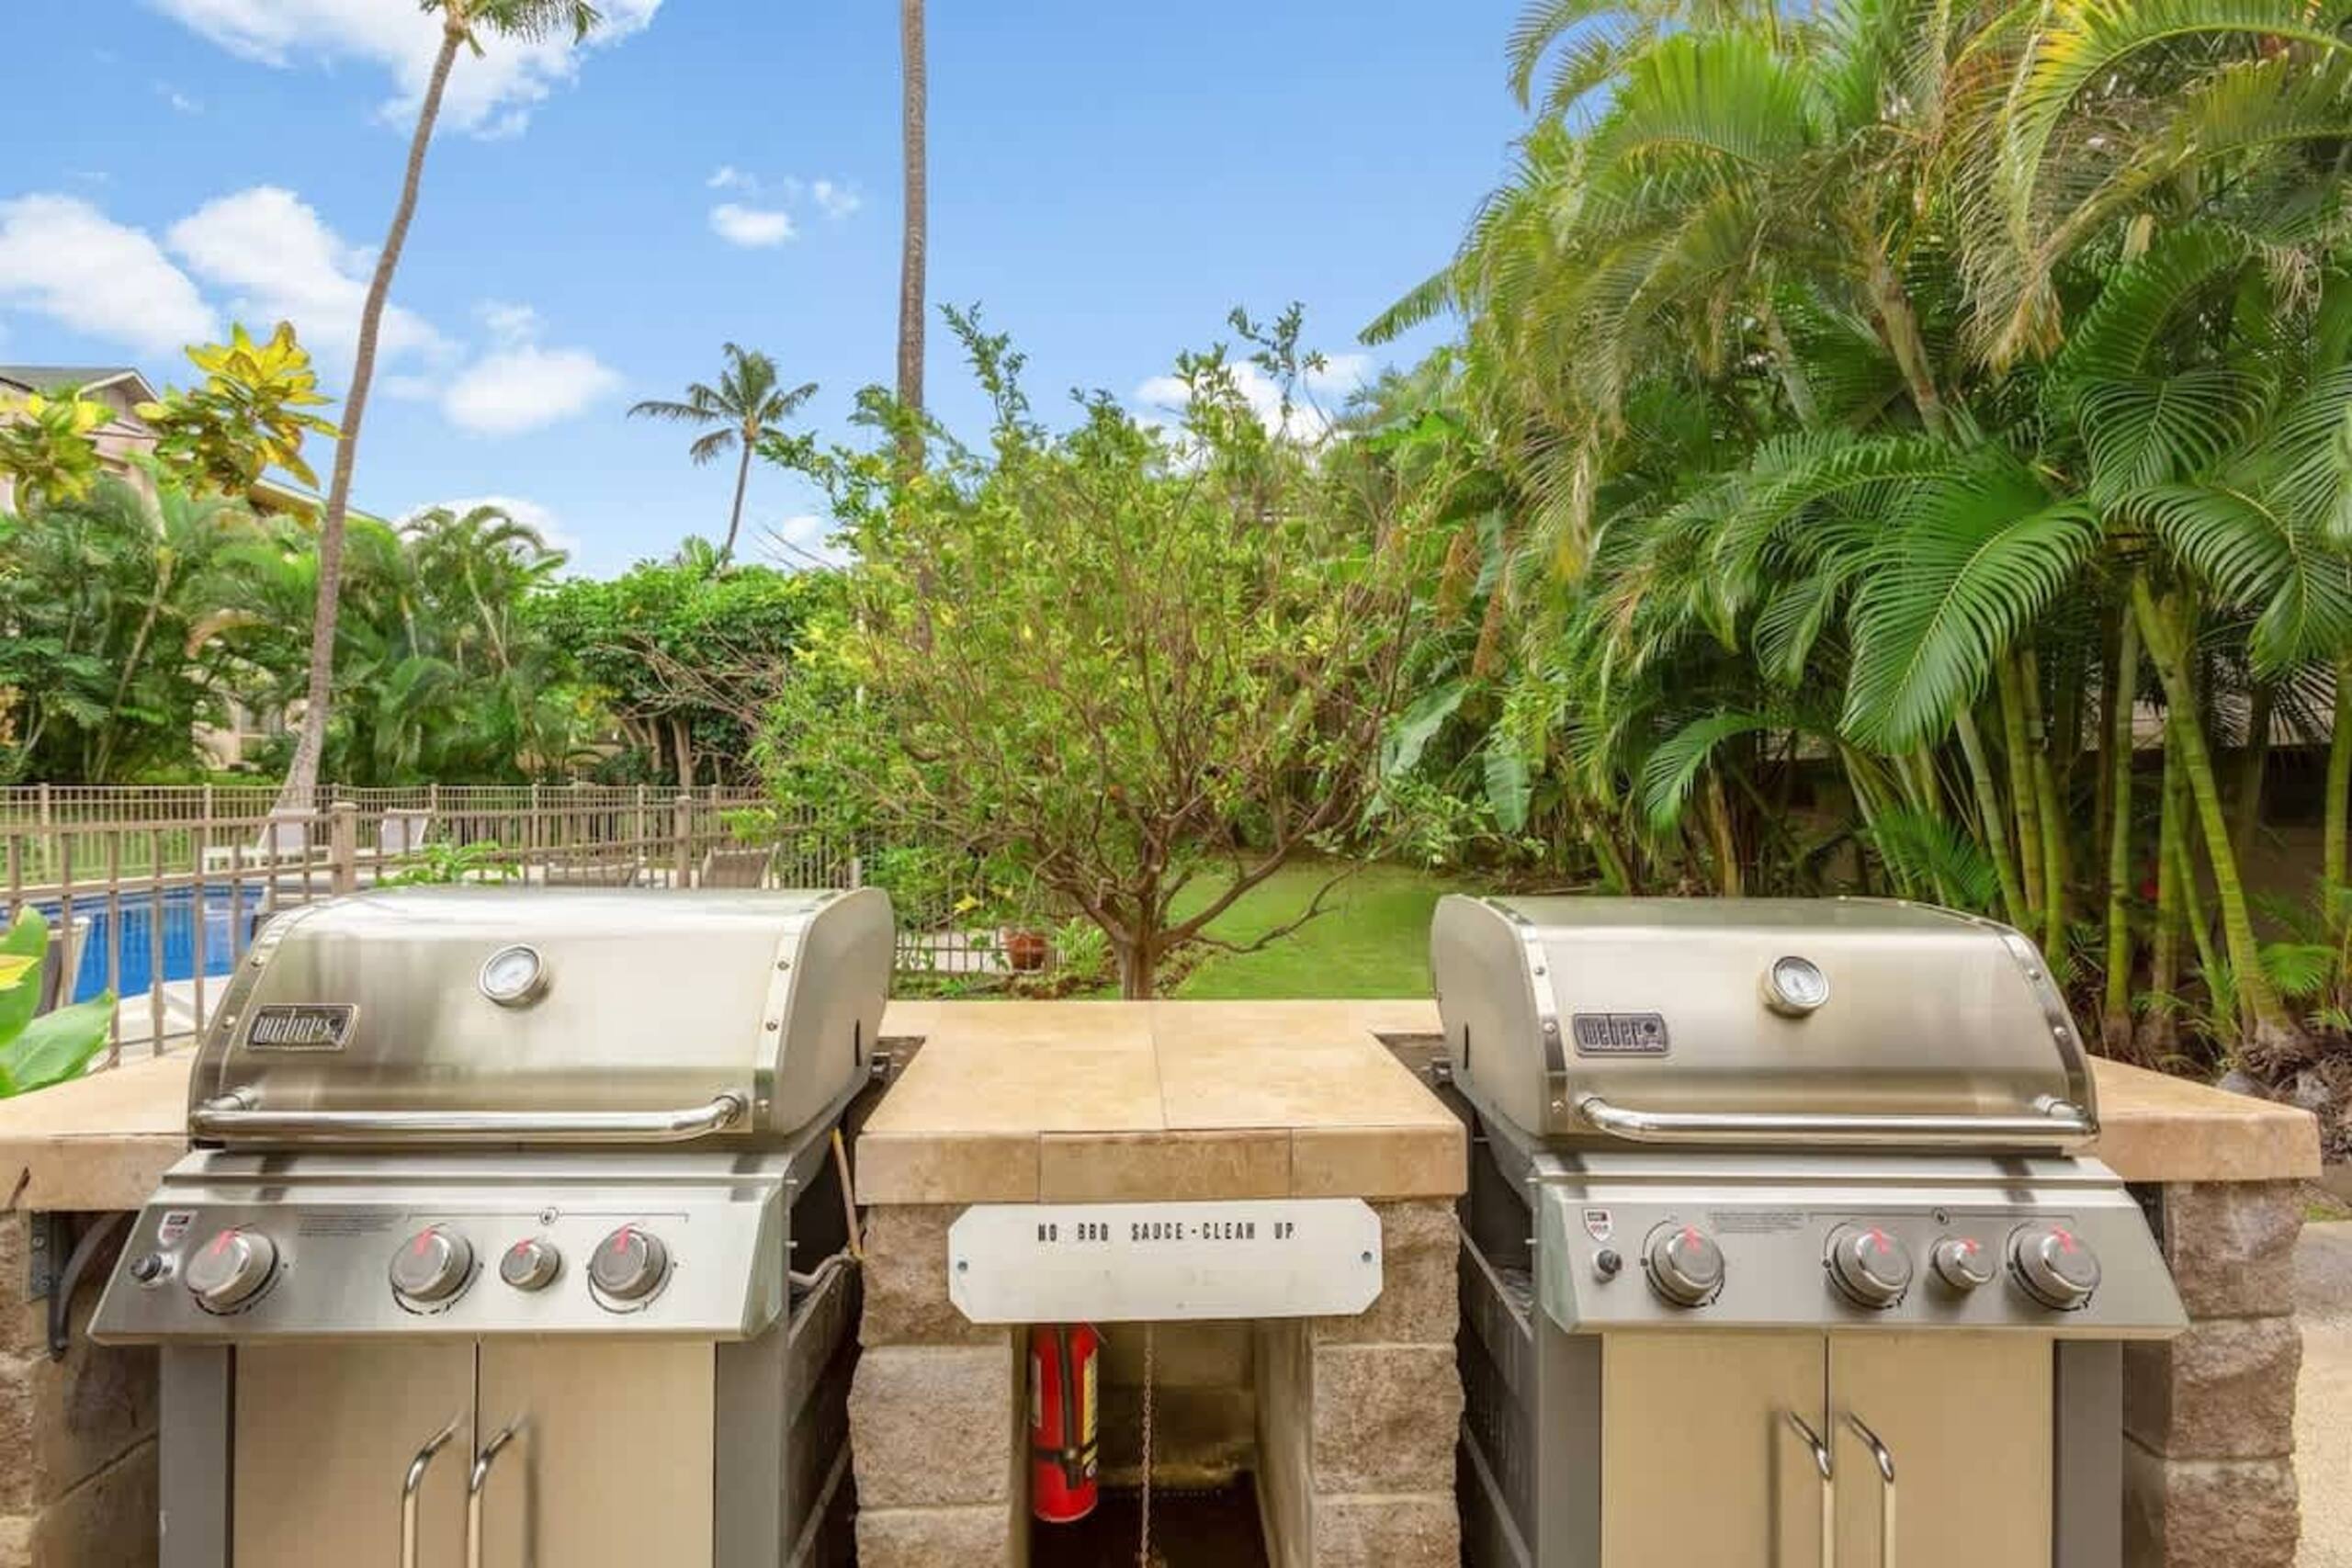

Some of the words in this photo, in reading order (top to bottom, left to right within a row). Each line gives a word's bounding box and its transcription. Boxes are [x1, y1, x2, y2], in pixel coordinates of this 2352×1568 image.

[1580, 1014, 1645, 1048] weber
[1037, 1223, 1057, 1242] NO
[1274, 1222, 1295, 1240] UP
